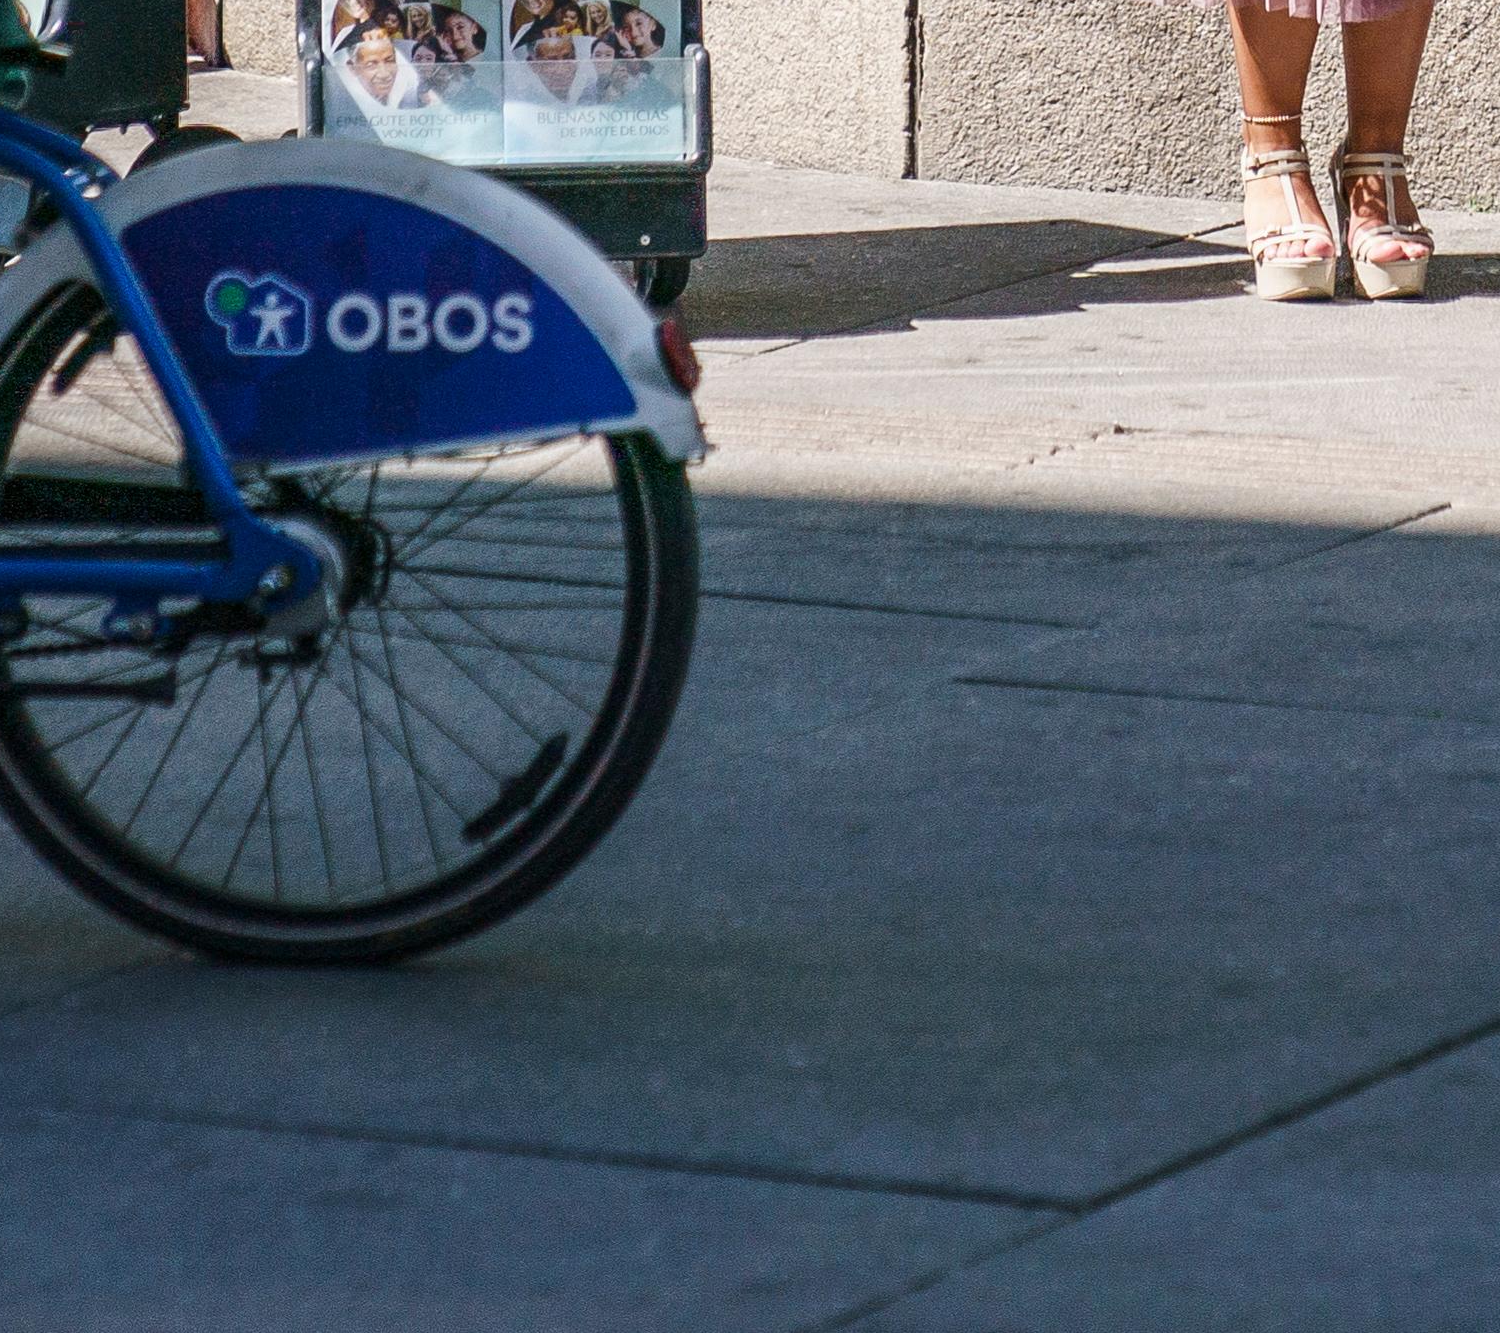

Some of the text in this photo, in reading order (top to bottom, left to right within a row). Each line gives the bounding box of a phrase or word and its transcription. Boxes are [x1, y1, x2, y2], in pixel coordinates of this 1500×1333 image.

[336, 113, 488, 127] EINE GUTE BOTSCHAFT
[536, 110, 669, 125] BUENAS NOTICIAS
[381, 126, 444, 139] VON GOTT
[560, 124, 671, 138] DE PARTE DE DIOS
[325, 291, 535, 354] OBOS
